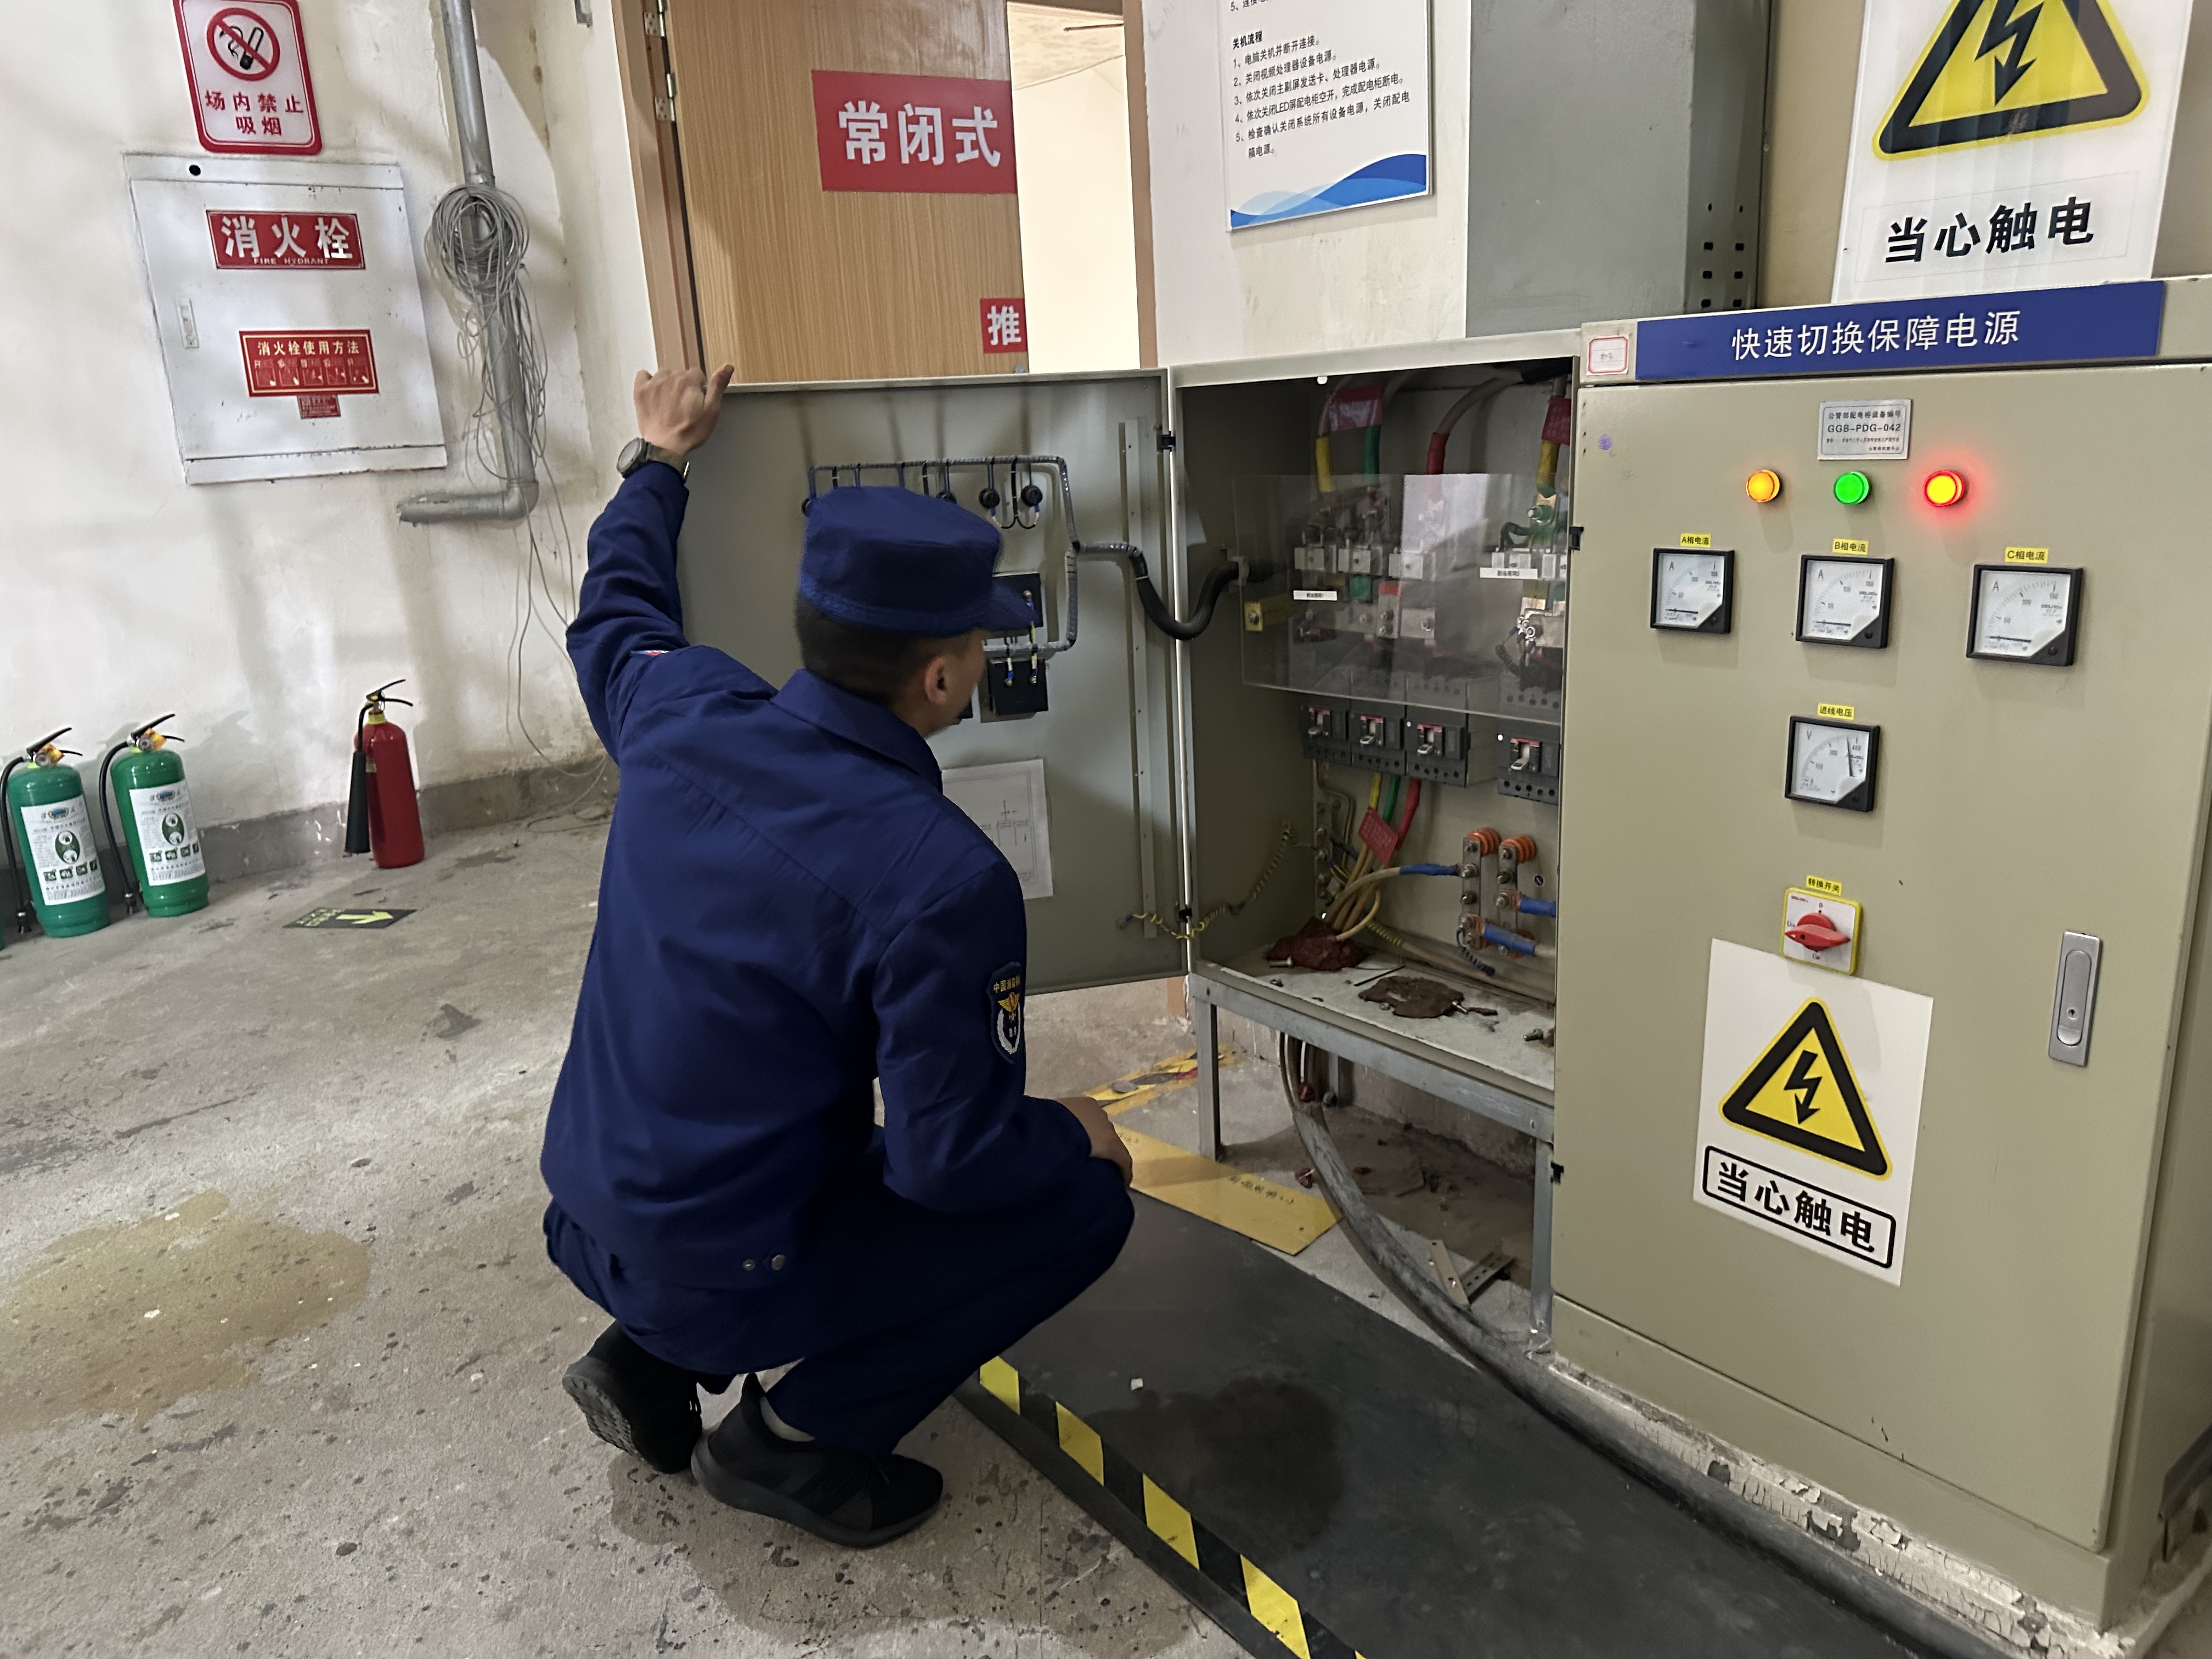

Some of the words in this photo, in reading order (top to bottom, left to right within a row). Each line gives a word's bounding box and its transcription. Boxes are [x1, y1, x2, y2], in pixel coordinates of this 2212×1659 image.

[1233, 30, 1262, 50] 关机流程
[1233, 35, 1319, 68] 1、电脑关机并断开连接。
[1233, 50, 1336, 87] 2、关闭视频处理器设备电源。
[205, 91, 303, 114] 场内禁止
[236, 116, 282, 136] 吸烟
[839, 100, 1001, 167] 常闭式
[221, 215, 353, 259] 消火栓
[1885, 196, 2094, 263] 当心触电
[987, 305, 1022, 346] 推
[1731, 308, 2021, 361] 快速切换保障电源
[257, 340, 359, 357] 消火栓使用方法
[1827, 424, 1901, 433] GGB-PDG-042
[1681, 536, 1709, 545] A相电流
[1835, 541, 1866, 552] B相电流
[2007, 550, 2045, 561] C相电流
[1669, 561, 1674, 570] A
[1818, 569, 1824, 579] A
[1992, 581, 1999, 591] A
[1819, 706, 1853, 718] 进线电压
[1807, 729, 1812, 740] V
[1808, 877, 1839, 893] 转换开关
[1718, 1161, 1875, 1253] 当心触电
